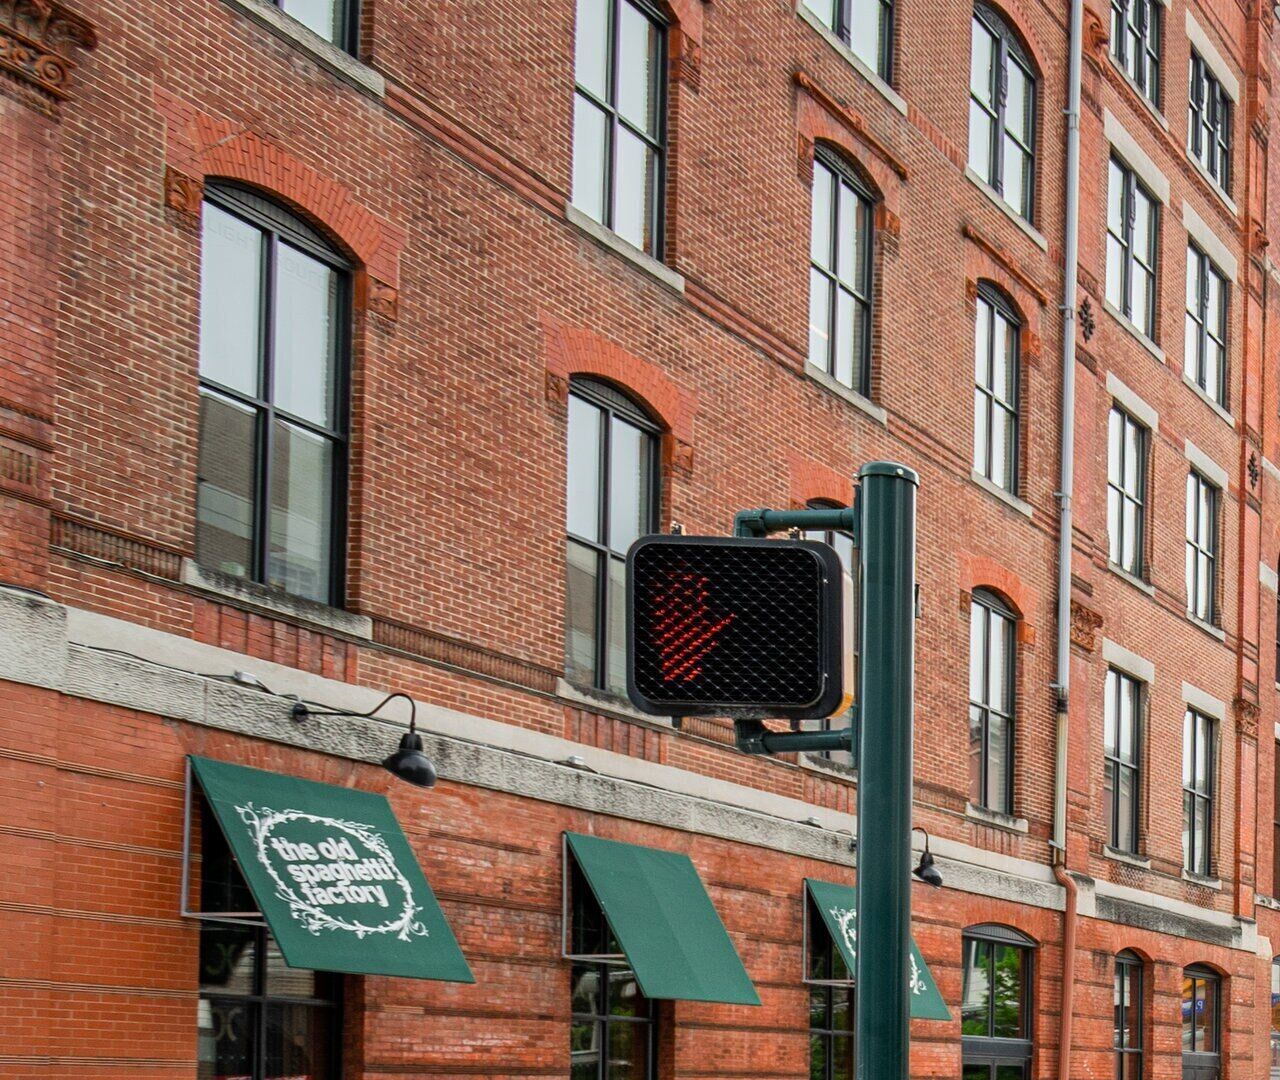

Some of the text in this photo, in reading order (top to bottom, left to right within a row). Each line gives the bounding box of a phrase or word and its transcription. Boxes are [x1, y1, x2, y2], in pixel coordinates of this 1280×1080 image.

[271, 837, 358, 861] the old
[287, 858, 395, 886] spaghetti
[300, 882, 389, 907] factory
